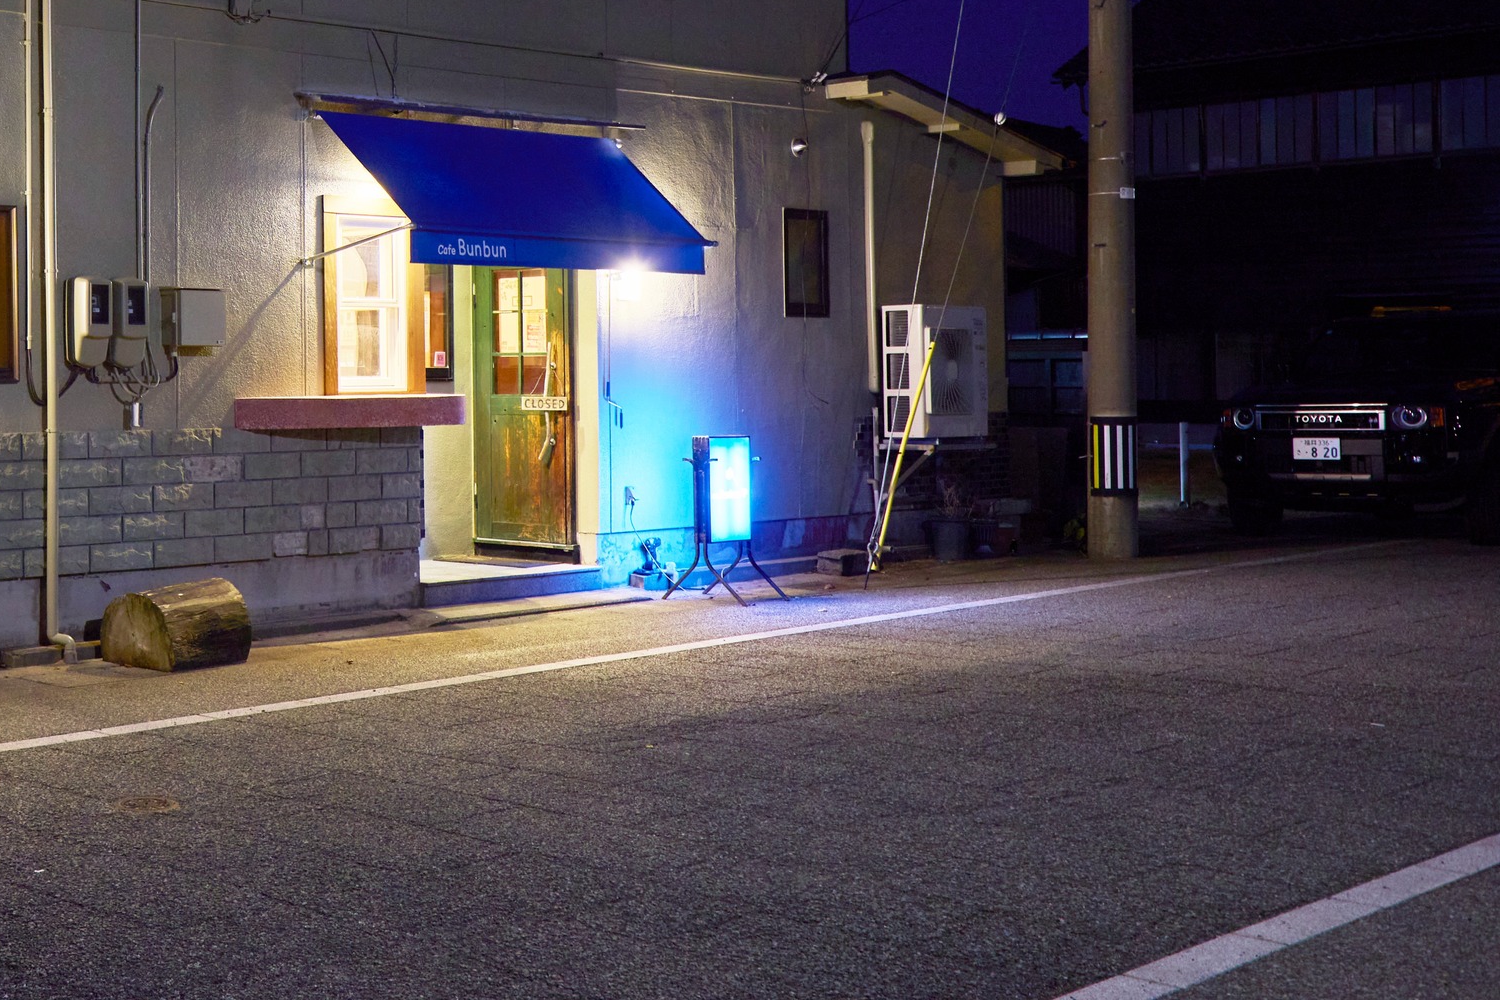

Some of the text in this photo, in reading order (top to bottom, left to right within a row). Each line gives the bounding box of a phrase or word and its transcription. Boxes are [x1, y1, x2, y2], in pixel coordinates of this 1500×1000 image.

[437, 238, 507, 258] Cafe Bunbun
[524, 398, 565, 409] CLOSED
[1295, 415, 1342, 423] TOYOTA
